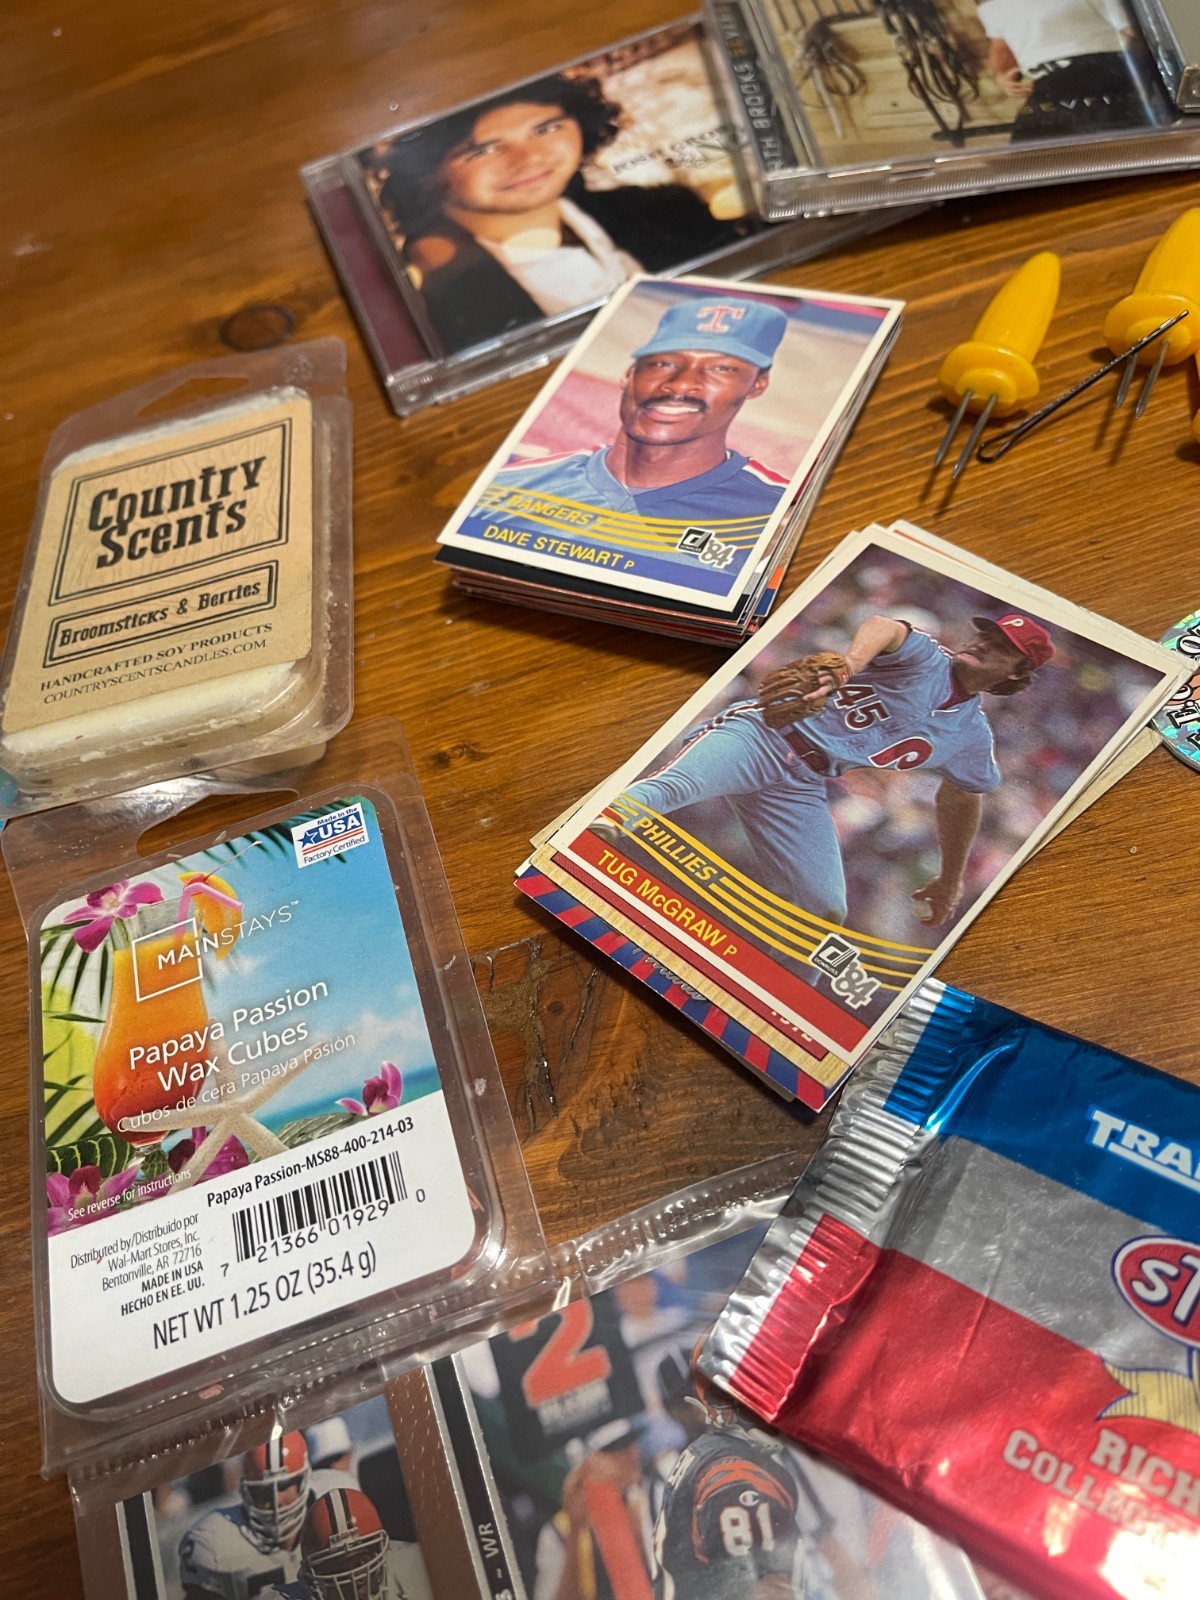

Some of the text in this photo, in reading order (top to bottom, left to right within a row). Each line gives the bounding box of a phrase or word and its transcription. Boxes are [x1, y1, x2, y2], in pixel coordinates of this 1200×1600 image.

[733, 62, 772, 129] BROOKS
[696, 303, 746, 333] T
[88, 455, 267, 536] Country
[504, 493, 594, 527] RANGERS
[96, 500, 247, 569] Scents
[483, 525, 636, 571] DAVE STEWART P
[58, 581, 261, 648] Broomsticks & Berries
[40, 622, 273, 692] HANDCRAFTED SOY PRODUCTS
[43, 638, 267, 704] COUNTRYSCENTSCANDLES.COM
[832, 683, 893, 732] 45
[317, 807, 358, 826] Made in the
[318, 814, 361, 840] USA
[303, 835, 366, 864] Factory Certified
[631, 816, 721, 883] PHILLIES
[597, 849, 739, 958] TUG McGRAW P
[128, 980, 329, 1070] Papaya Passion
[116, 1031, 356, 1133] Cubos de cera Papaya Pasión
[156, 1021, 309, 1093] Wax Cubes
[207, 1116, 414, 1207] Papaya Passion-MS88-400-214-03
[68, 1168, 192, 1221] See reverse for instructions
[70, 1213, 199, 1269] Distributed by/Distribuido por
[108, 1230, 201, 1272] Wal-Mart Stores, Inc.
[220, 1188, 426, 1278] 7 21366 01929 0
[102, 1245, 202, 1291] Bentonville, AR 72716
[121, 1276, 205, 1316] HECHO EN EE. UU.
[141, 1261, 204, 1293] MADE IN USA
[153, 1240, 377, 1350] NET WT 1.25 OZ (35.4 g)
[478, 1522, 499, 1559] WR
[720, 1501, 775, 1557] 81
